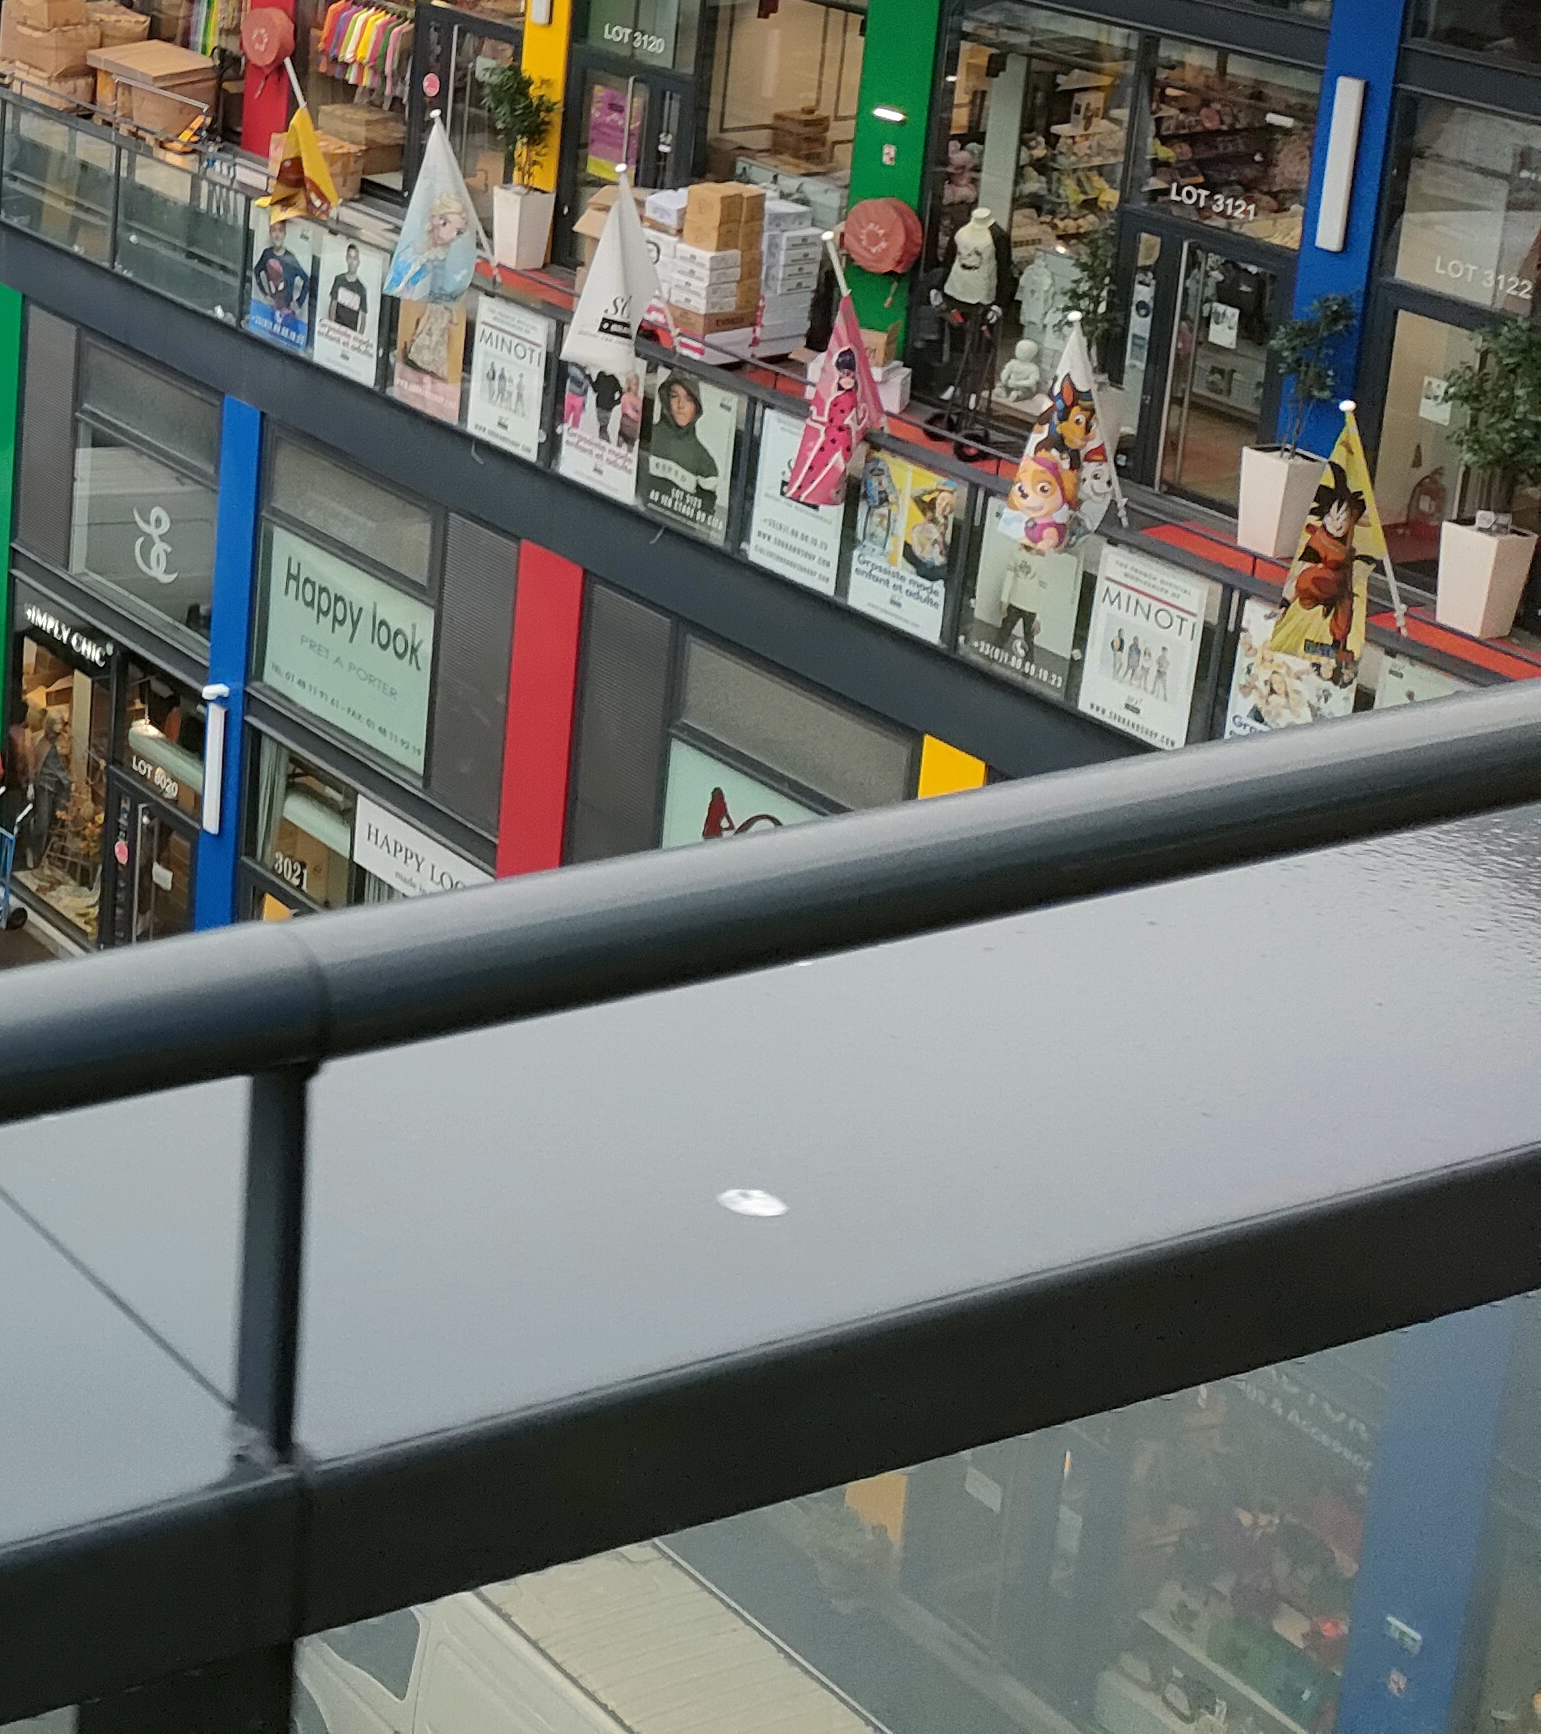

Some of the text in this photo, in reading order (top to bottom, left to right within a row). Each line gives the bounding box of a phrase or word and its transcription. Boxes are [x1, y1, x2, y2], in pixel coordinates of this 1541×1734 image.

[604, 23, 666, 55] LOT 3120
[1169, 181, 1257, 222] LOT 3121
[1434, 255, 1533, 300] LOT 3122
[480, 328, 542, 367] MINOTI
[24, 602, 107, 668] SIMPLY CHIC
[284, 556, 425, 672] Happy look
[1101, 585, 1198, 641] MINOTI
[300, 634, 398, 701] PRET A PORTER
[132, 754, 153, 779] LOT
[367, 822, 426, 873] HAPPY
[273, 850, 309, 893] 3021
